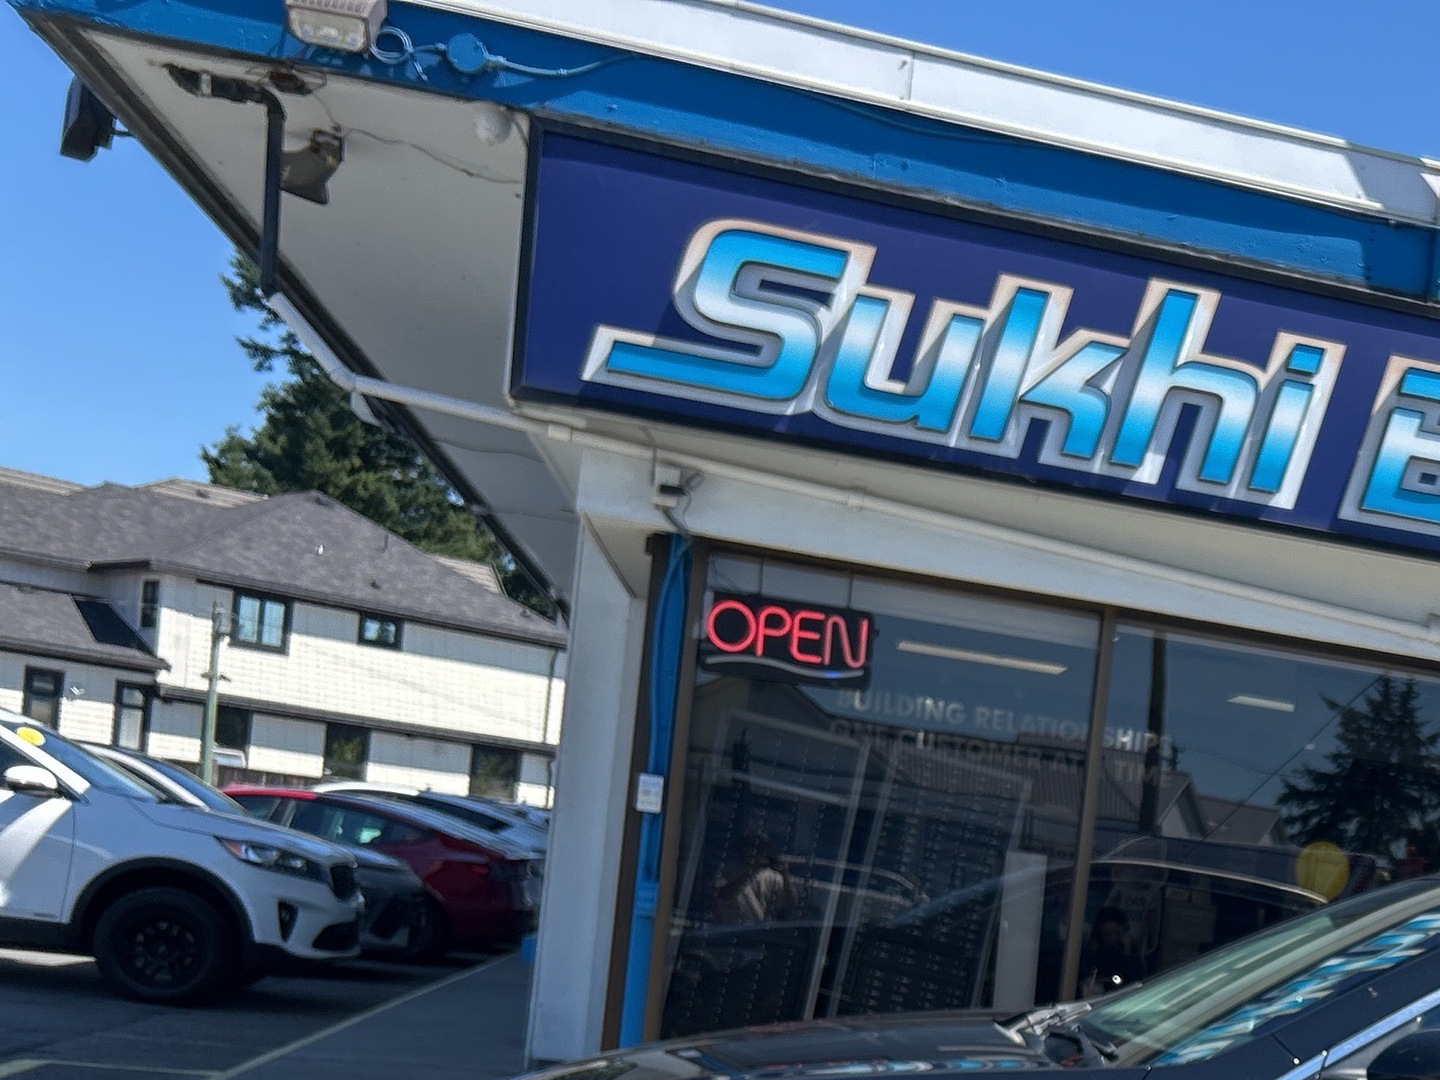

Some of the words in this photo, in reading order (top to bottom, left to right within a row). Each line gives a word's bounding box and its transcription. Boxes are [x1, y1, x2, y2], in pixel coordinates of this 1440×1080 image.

[581, 217, 1347, 509] Sukhi
[707, 599, 869, 668] OPEN
[974, 706, 1174, 758] RELATIOSHIPS
